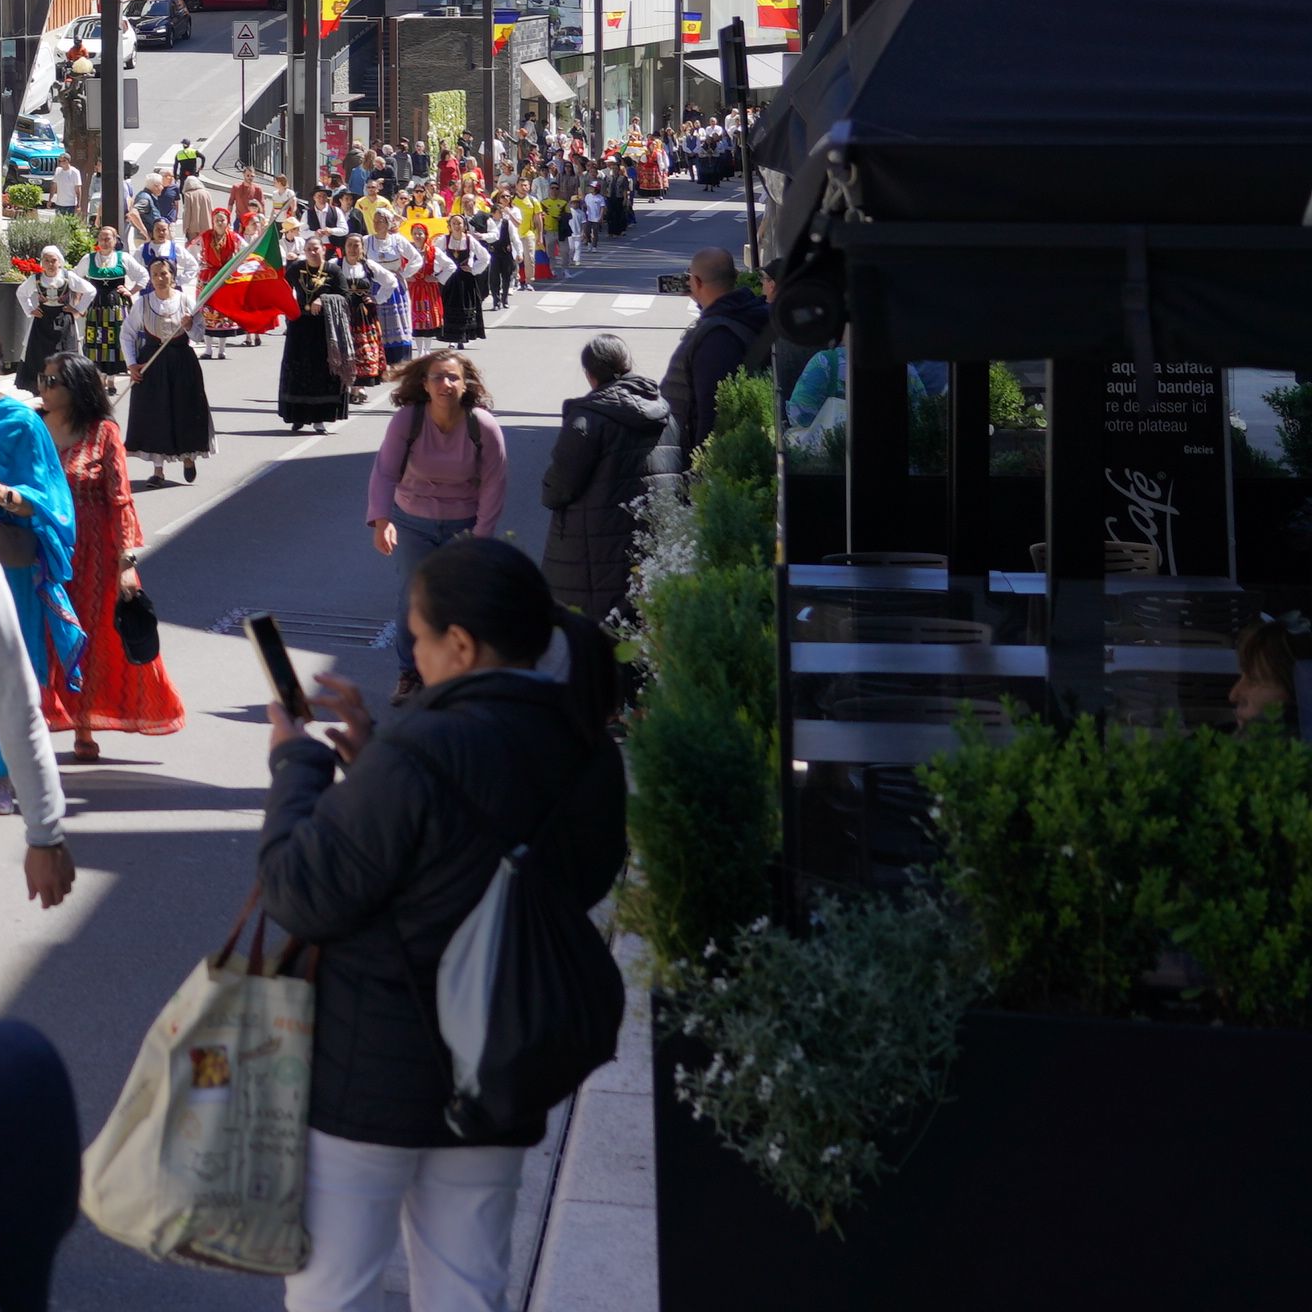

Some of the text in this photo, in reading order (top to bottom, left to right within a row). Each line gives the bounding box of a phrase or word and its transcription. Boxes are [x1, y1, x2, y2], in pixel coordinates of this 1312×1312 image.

[1111, 362, 1137, 376] aqu
[1157, 380, 1215, 396] bandeja
[1123, 399, 1140, 413] de
[1147, 400, 1188, 413] aisser
[1192, 399, 1207, 413] ici
[1138, 419, 1188, 435] plateau
